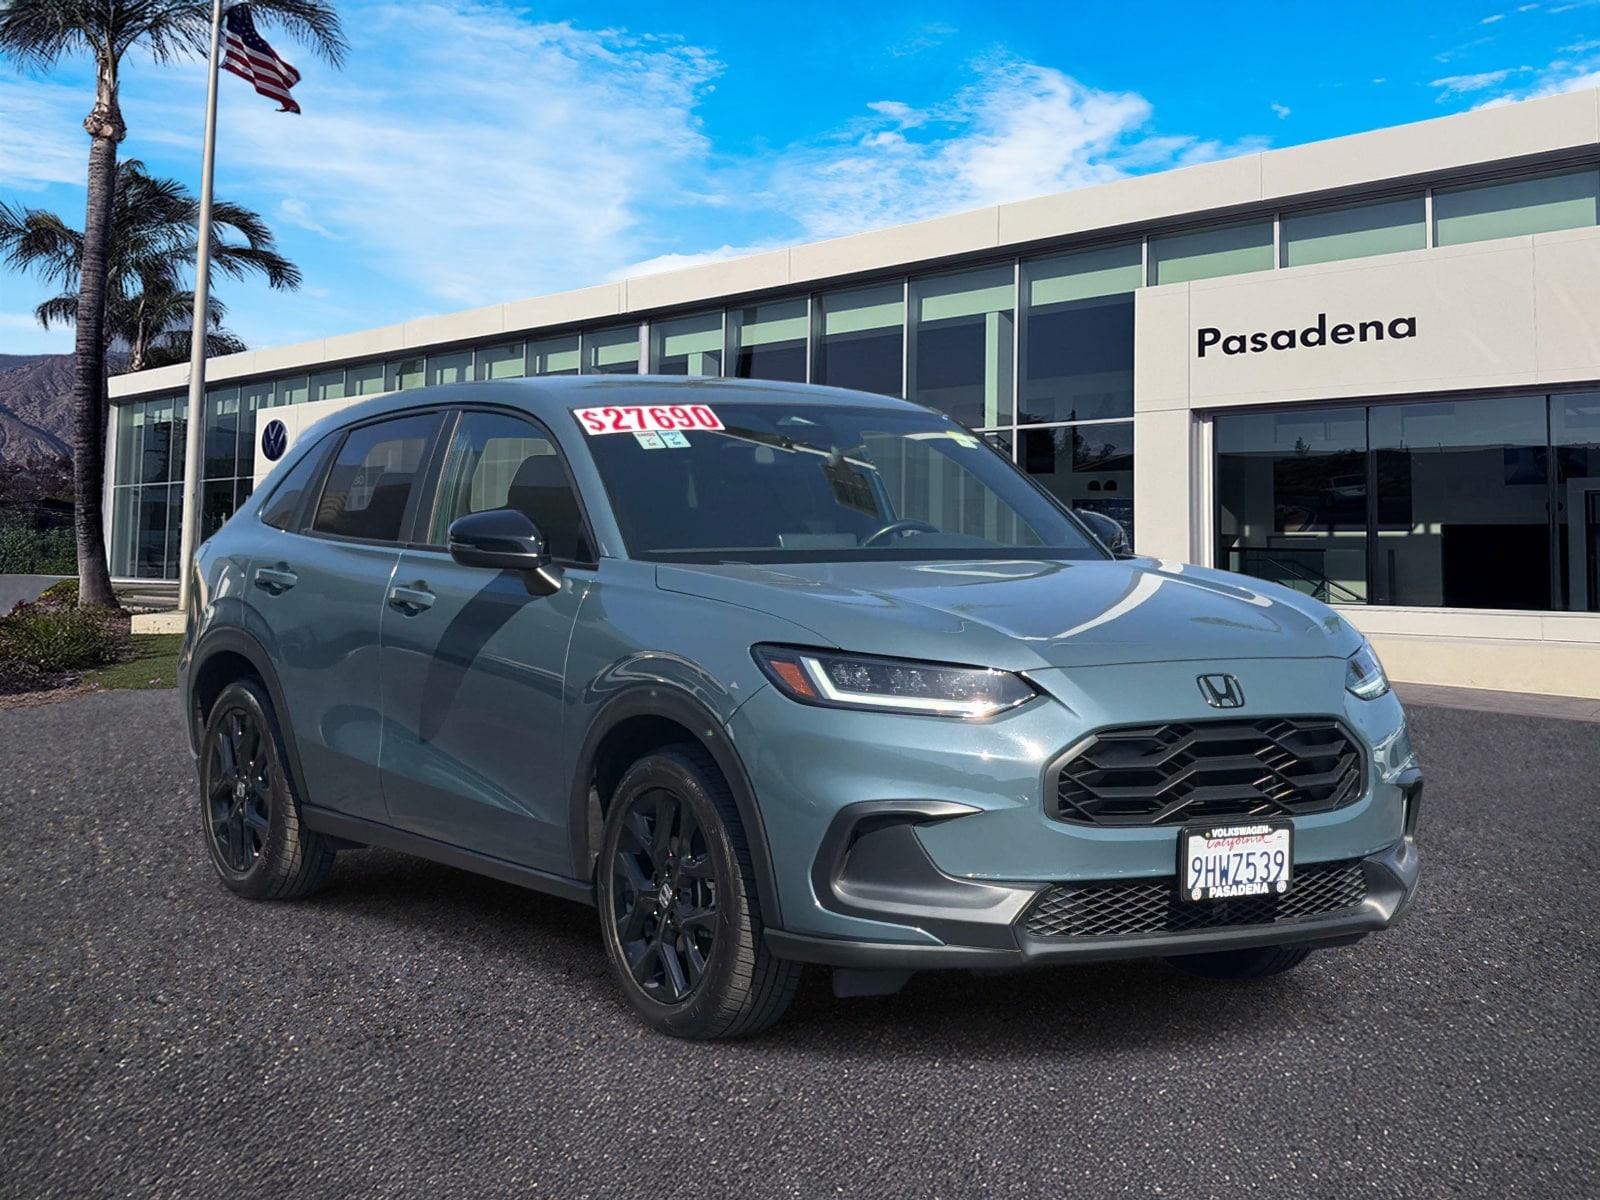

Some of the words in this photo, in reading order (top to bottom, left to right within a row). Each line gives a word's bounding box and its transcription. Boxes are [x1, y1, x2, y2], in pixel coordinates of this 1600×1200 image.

[1197, 313, 1417, 358] Pasadena
[582, 406, 719, 431] $27690
[1211, 825, 1269, 838] VOLKSWAGEN
[1191, 849, 1285, 889] 9HWZ539
[1209, 882, 1269, 899] PASADENA
